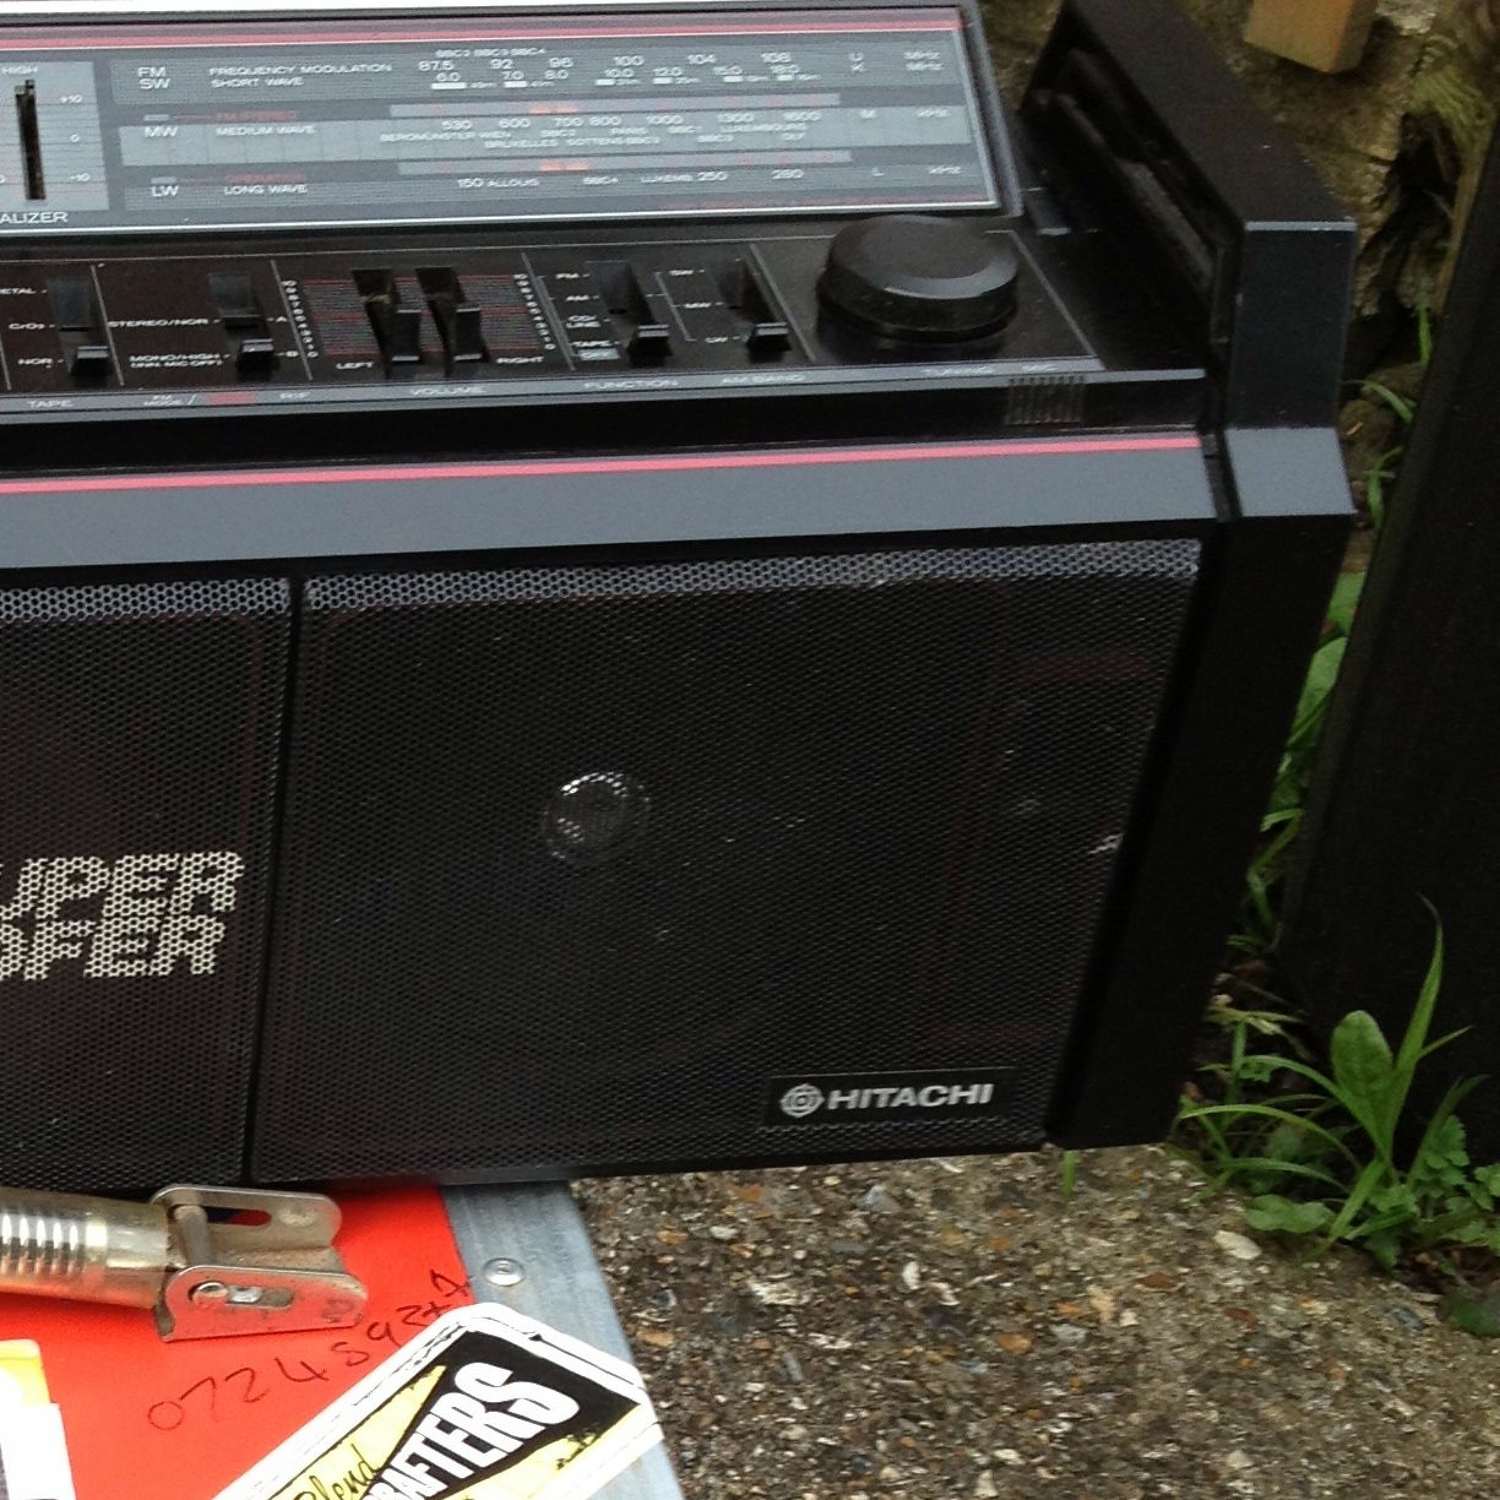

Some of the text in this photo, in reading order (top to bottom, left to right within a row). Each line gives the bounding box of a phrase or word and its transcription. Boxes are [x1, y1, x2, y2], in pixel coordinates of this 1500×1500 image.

[418, 60, 455, 71] 87.5
[490, 58, 514, 70] 92
[613, 55, 645, 66] 100
[687, 54, 717, 65] 104
[2, 65, 39, 75] HIGH
[137, 64, 392, 78] FM FREQUENCY MODULATION
[139, 77, 304, 89] SW SHORT WAVE
[144, 125, 316, 137] MW MEDIUM WAVE
[70, 133, 80, 143] 0
[151, 185, 179, 196] LW
[223, 185, 265, 195] LONG
[267, 183, 308, 194] WAVE
[335, 361, 374, 370] LEFT
[496, 355, 545, 364] RIGHT
[584, 378, 679, 390] FUNCTION
[410, 385, 488, 396] VOLUME
[26, 400, 73, 410] TAPE
[827, 1083, 995, 1110] HITACHI
